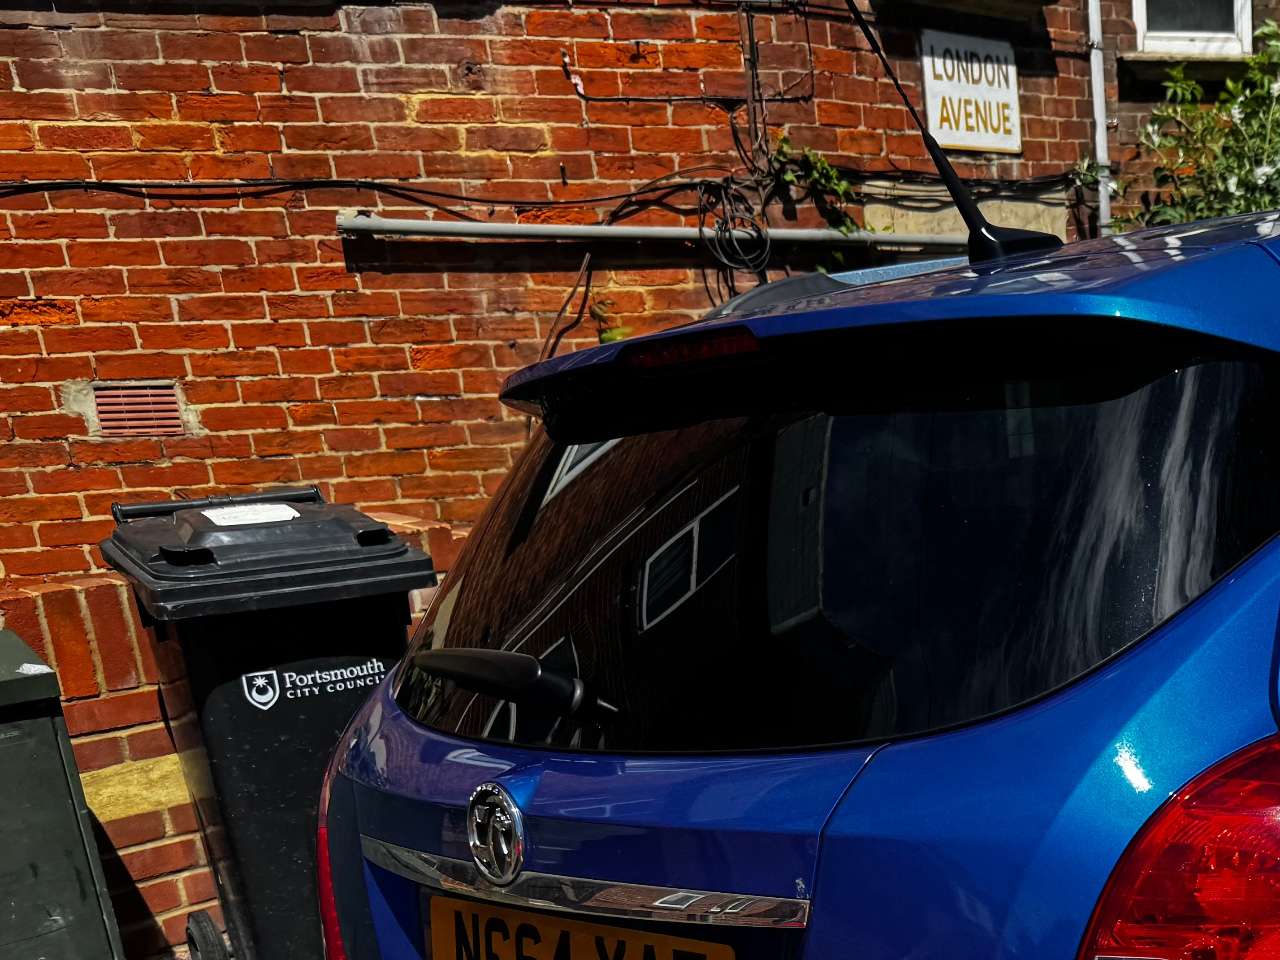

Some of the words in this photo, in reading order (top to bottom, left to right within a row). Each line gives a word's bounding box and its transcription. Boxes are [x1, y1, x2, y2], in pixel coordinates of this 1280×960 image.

[930, 44, 1011, 89] LONDON
[939, 95, 1013, 136] AVENUE
[283, 658, 386, 688] Portsmouth
[286, 686, 320, 699] CITY
[326, 674, 385, 692] COUNCI
